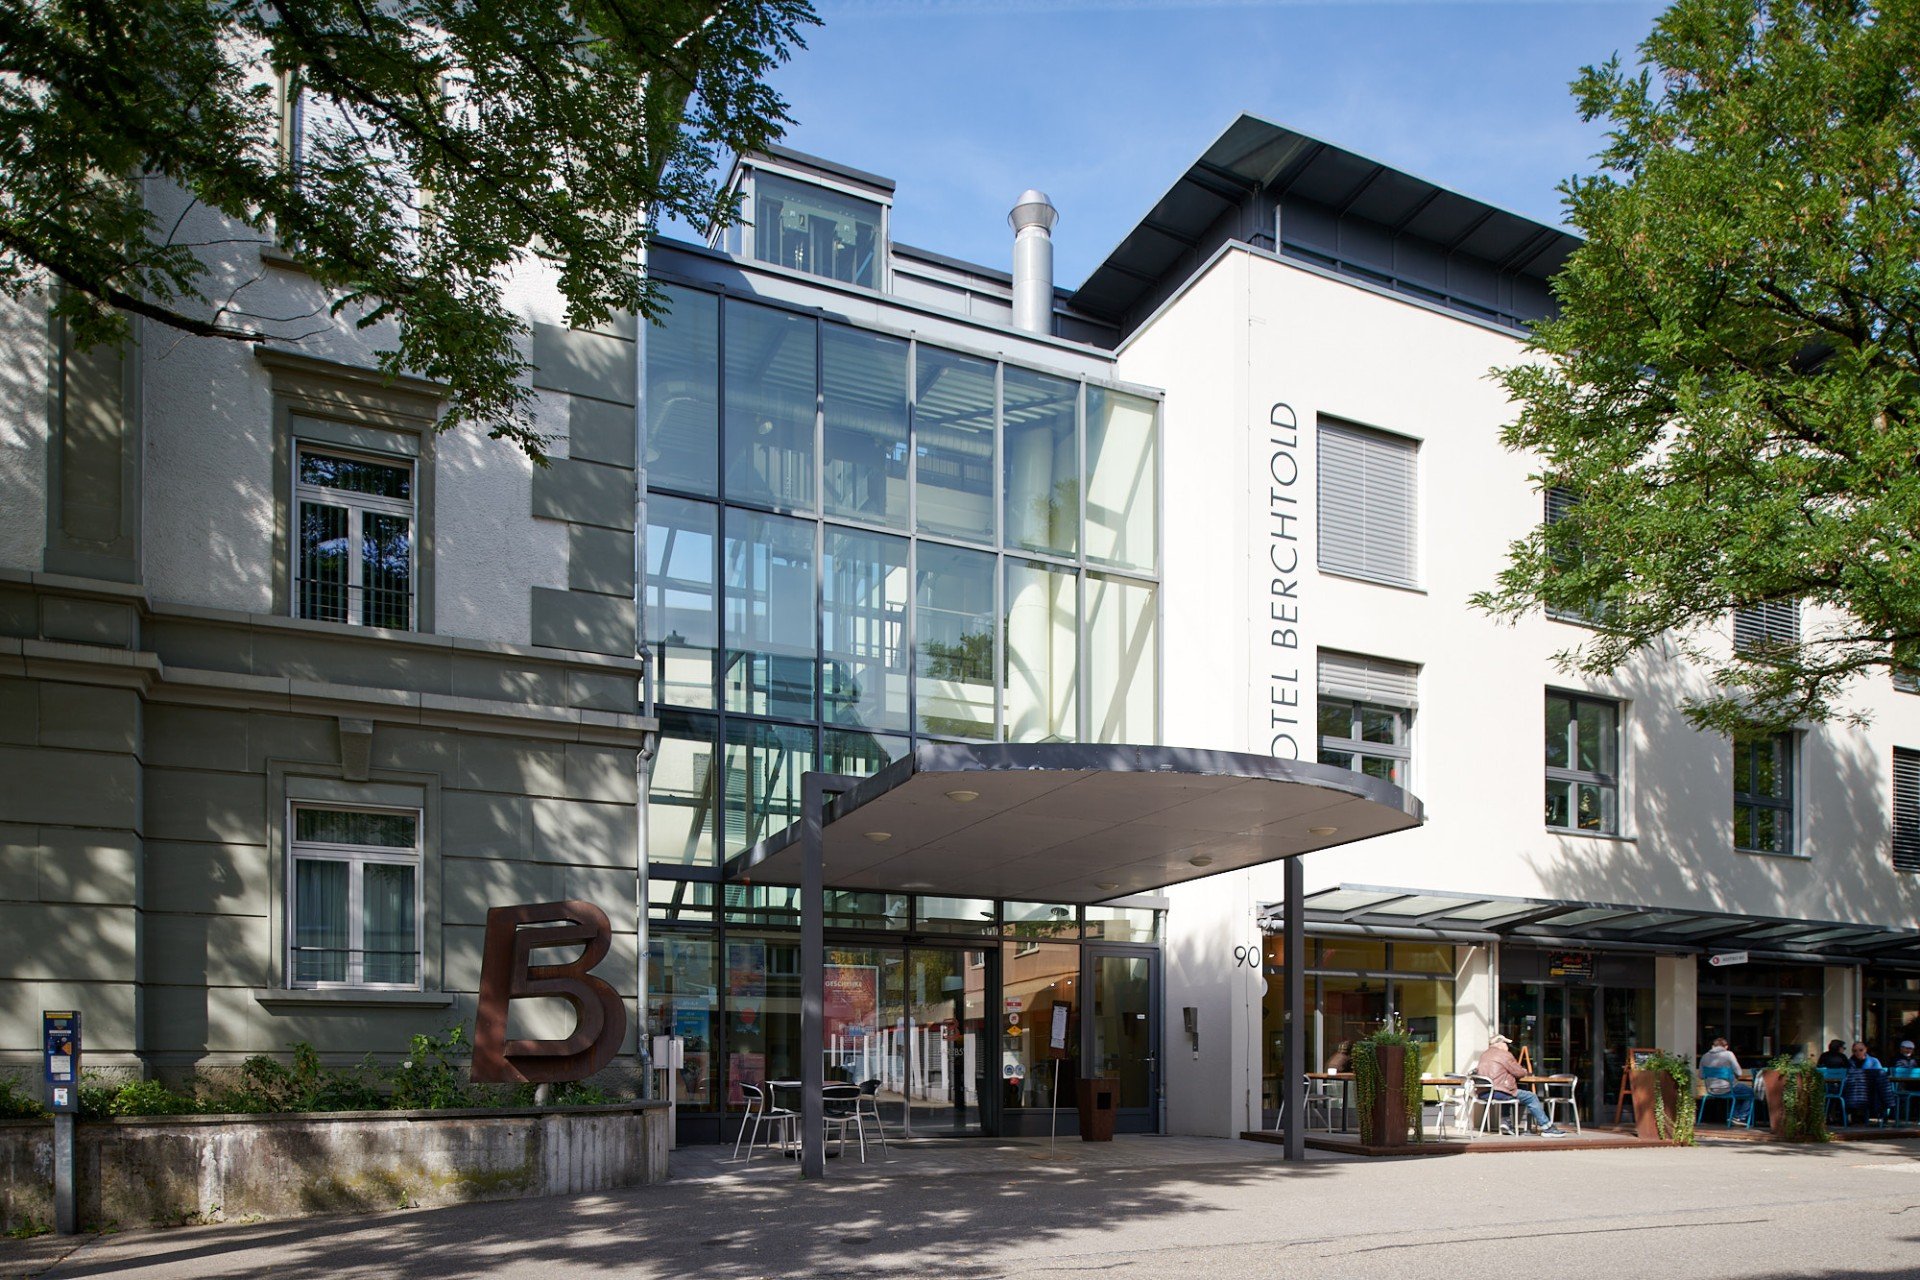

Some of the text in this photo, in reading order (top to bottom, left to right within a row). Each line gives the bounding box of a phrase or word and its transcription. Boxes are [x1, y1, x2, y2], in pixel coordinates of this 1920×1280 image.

[1270, 402, 1298, 760] OTEL BERCHTOLD
[470, 901, 627, 1083] B
[1234, 945, 1260, 968] 90
